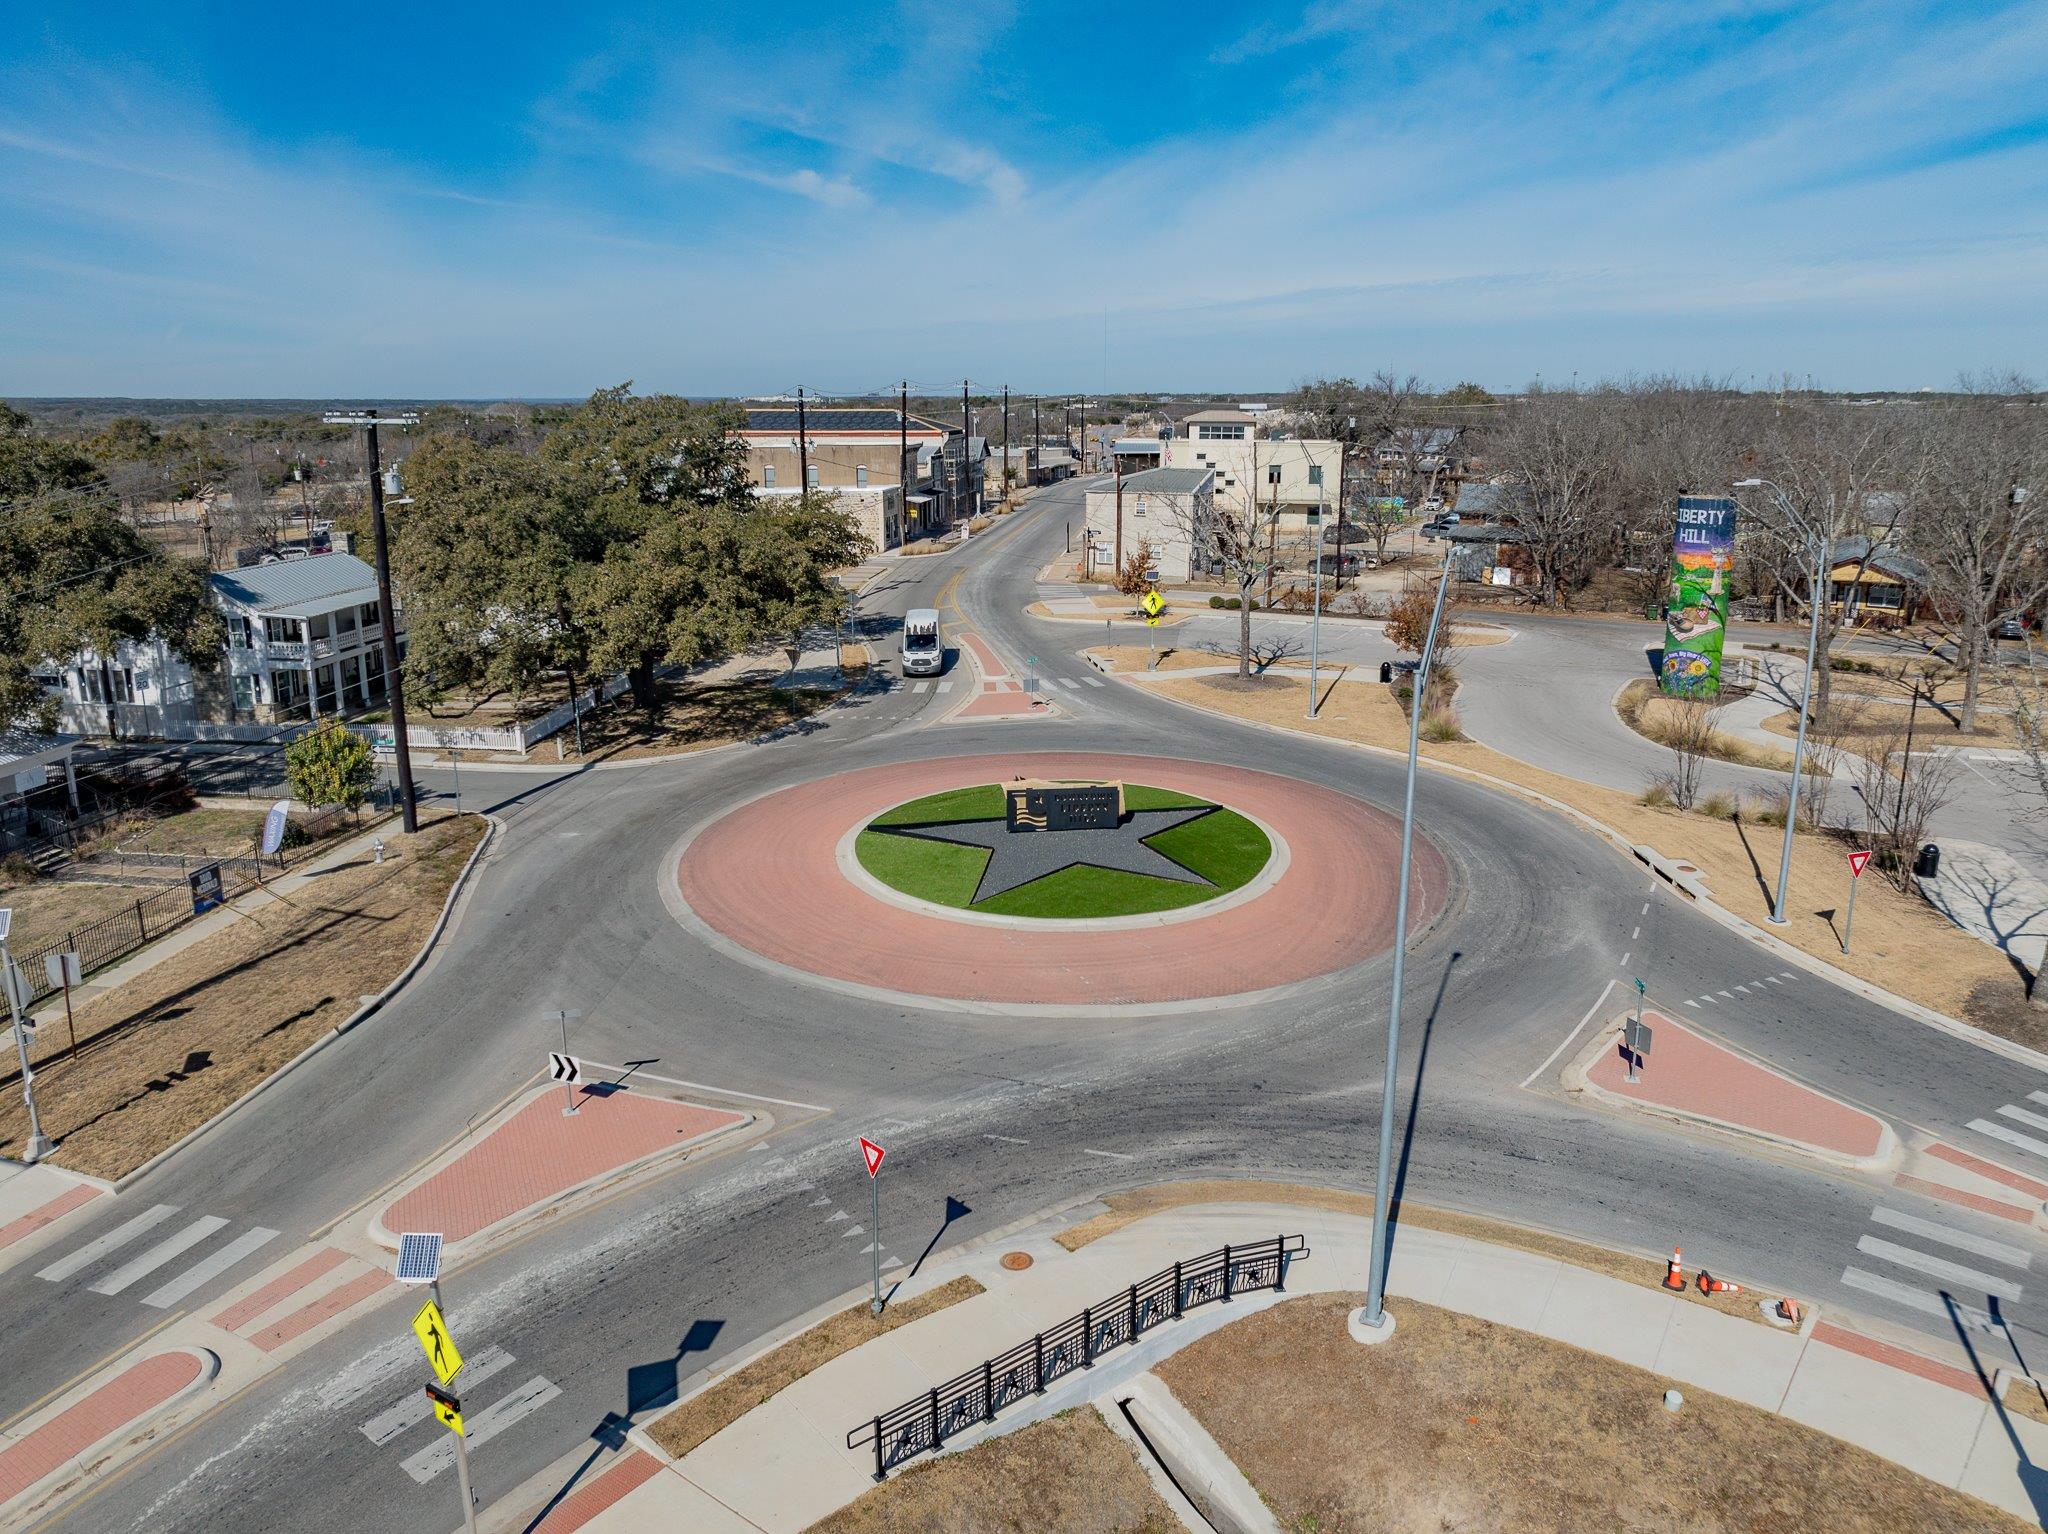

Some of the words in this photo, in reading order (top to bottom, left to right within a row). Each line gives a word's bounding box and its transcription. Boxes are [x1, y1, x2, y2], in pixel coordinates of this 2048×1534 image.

[1680, 528, 1710, 544] HILL
[136, 681, 147, 689] 20
[1061, 803, 1109, 812] LIBERTY
